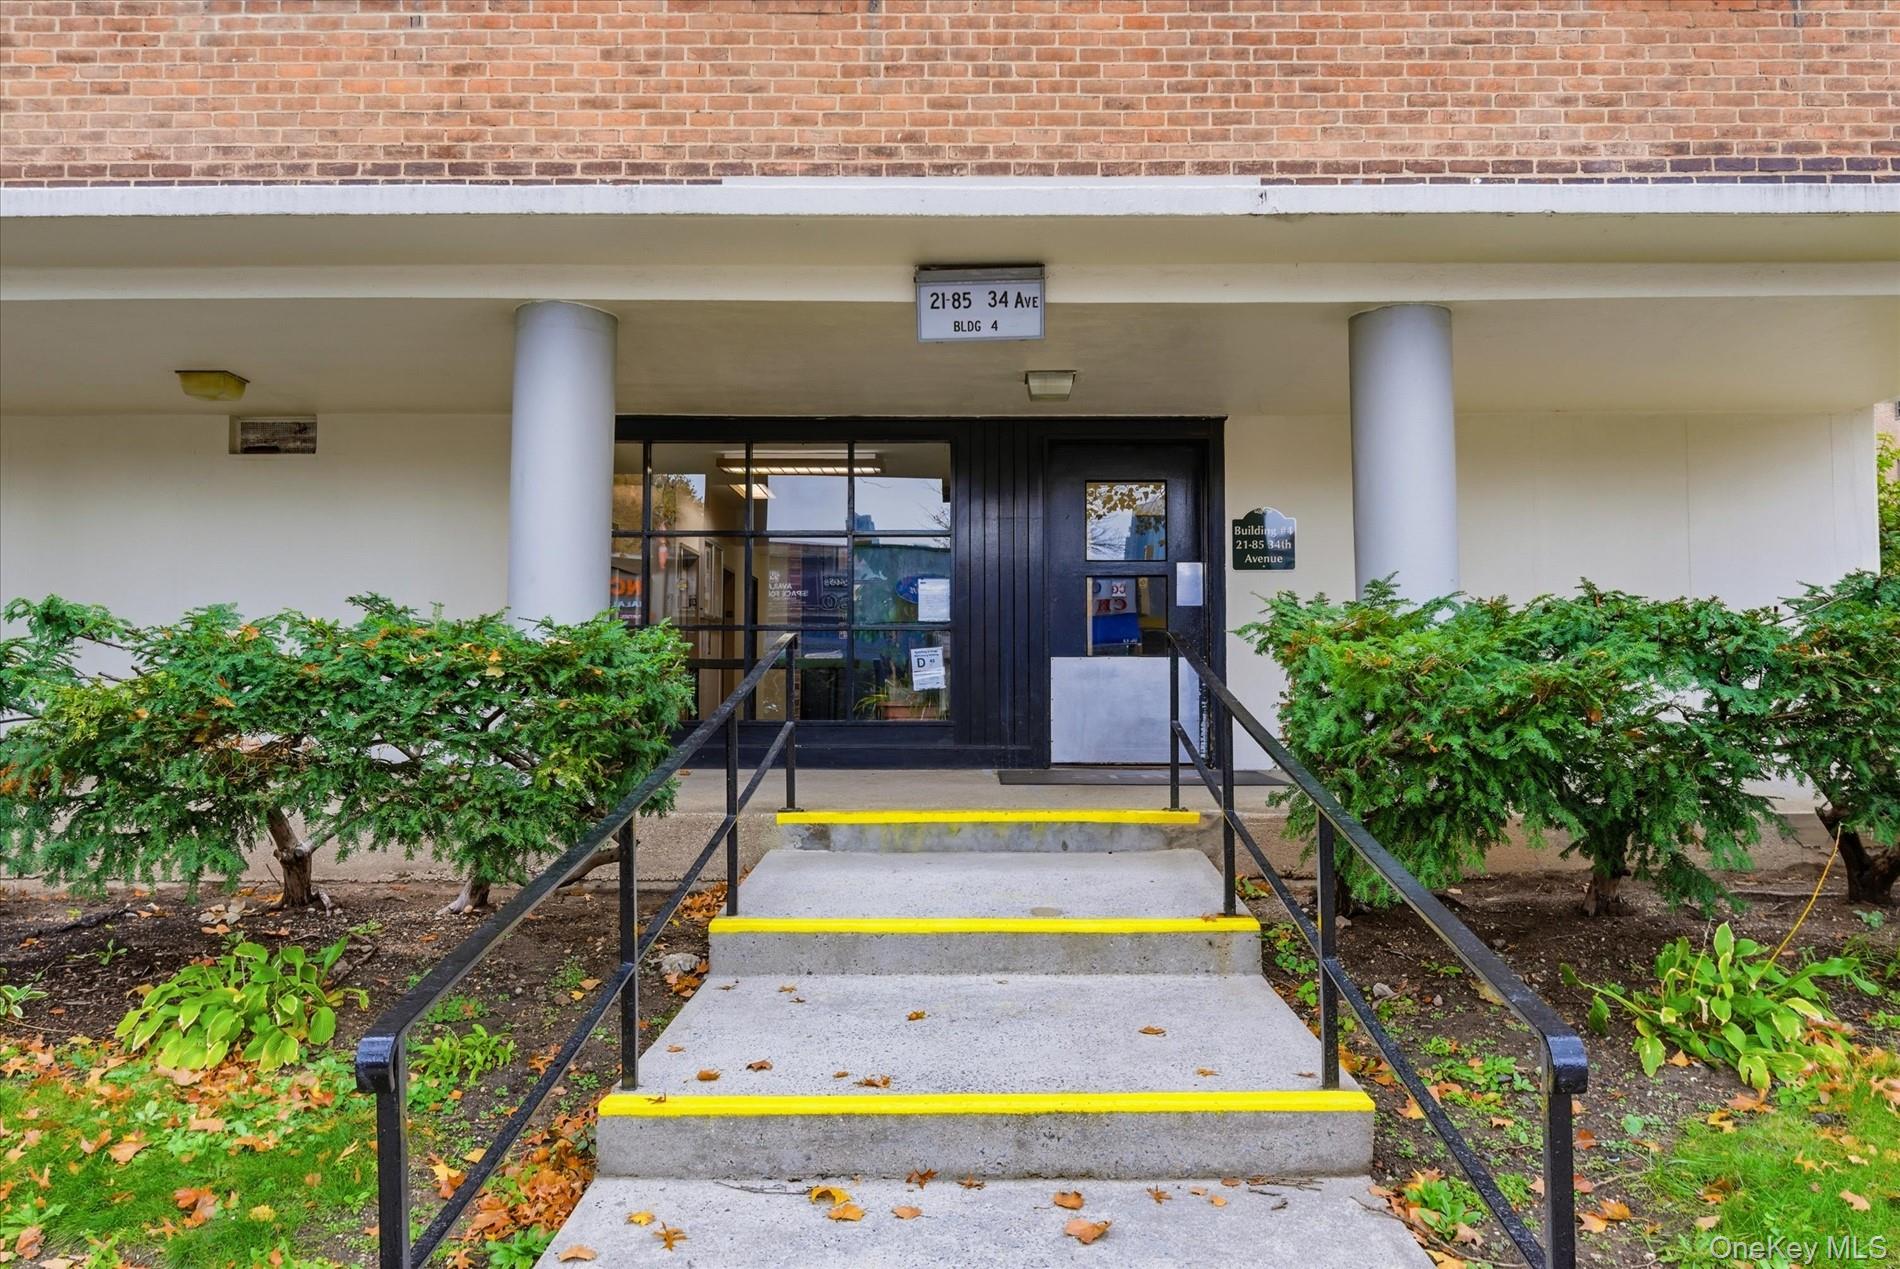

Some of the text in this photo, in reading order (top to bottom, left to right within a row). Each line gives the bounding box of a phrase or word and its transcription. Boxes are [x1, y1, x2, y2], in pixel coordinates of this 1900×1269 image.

[930, 292, 972, 309] 21-85
[987, 290, 1009, 309] 34
[953, 320, 998, 332] BLDG 4
[1234, 525, 1293, 537] Building #4
[1235, 539, 1292, 550] 21-85 34th
[1244, 554, 1283, 563] Avenue
